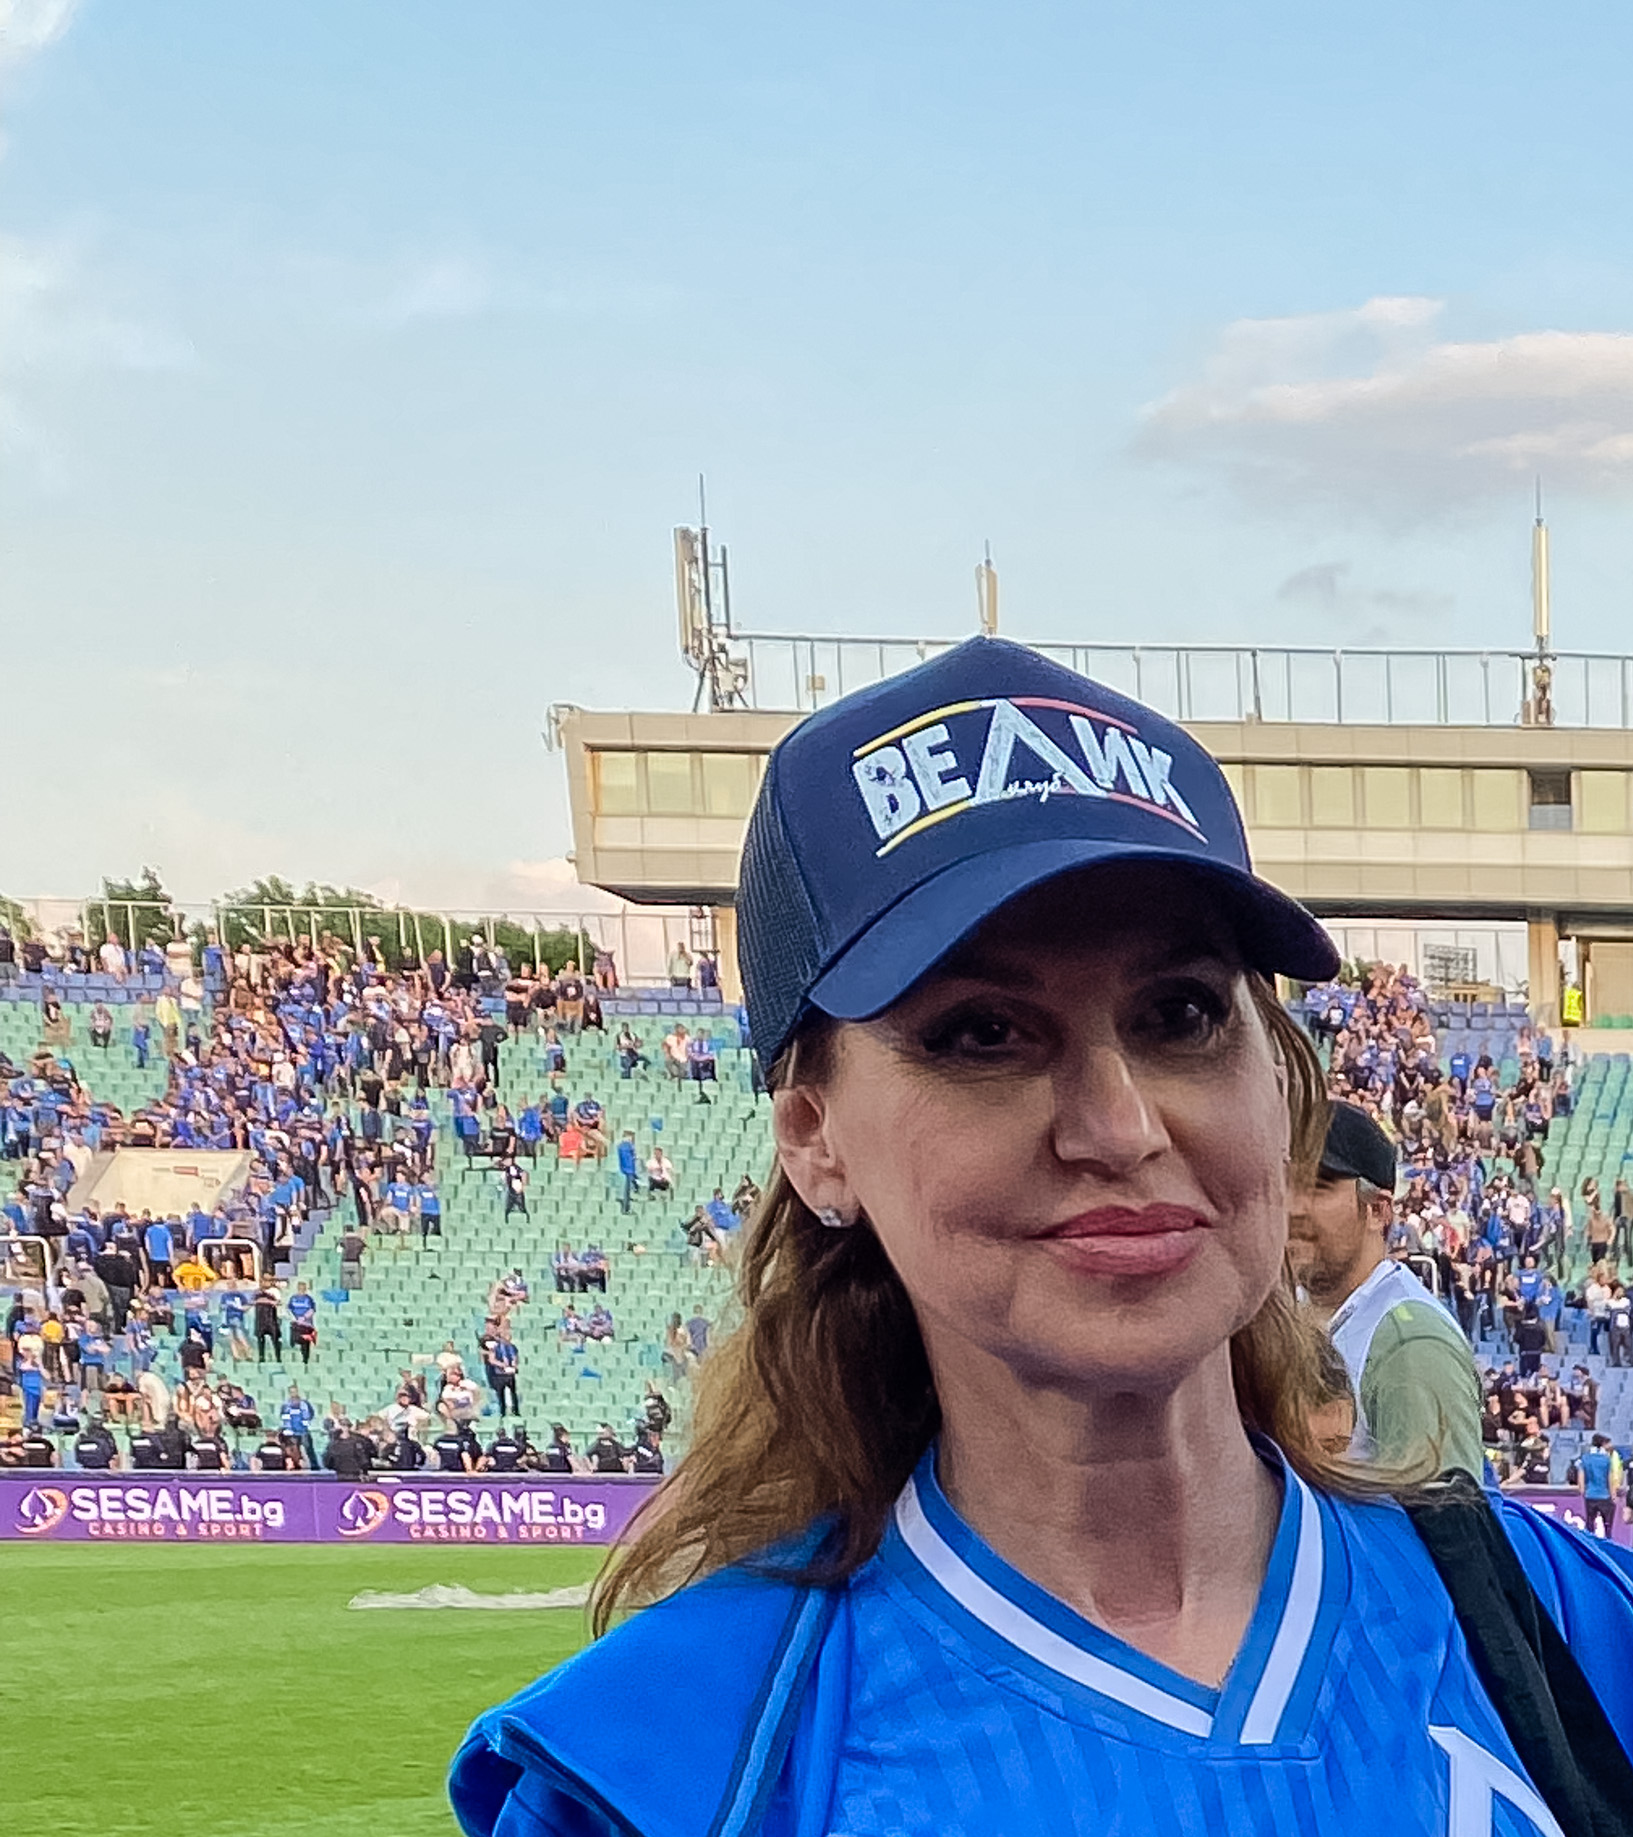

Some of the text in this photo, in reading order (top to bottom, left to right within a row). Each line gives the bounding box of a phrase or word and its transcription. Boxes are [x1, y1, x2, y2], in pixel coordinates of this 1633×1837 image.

[71, 1488, 285, 1527] SESAME.bg
[394, 1491, 605, 1529] SESAME.bg
[89, 1522, 263, 1536] CASINO & SPORT
[409, 1525, 583, 1539] CASINO & SPORT
